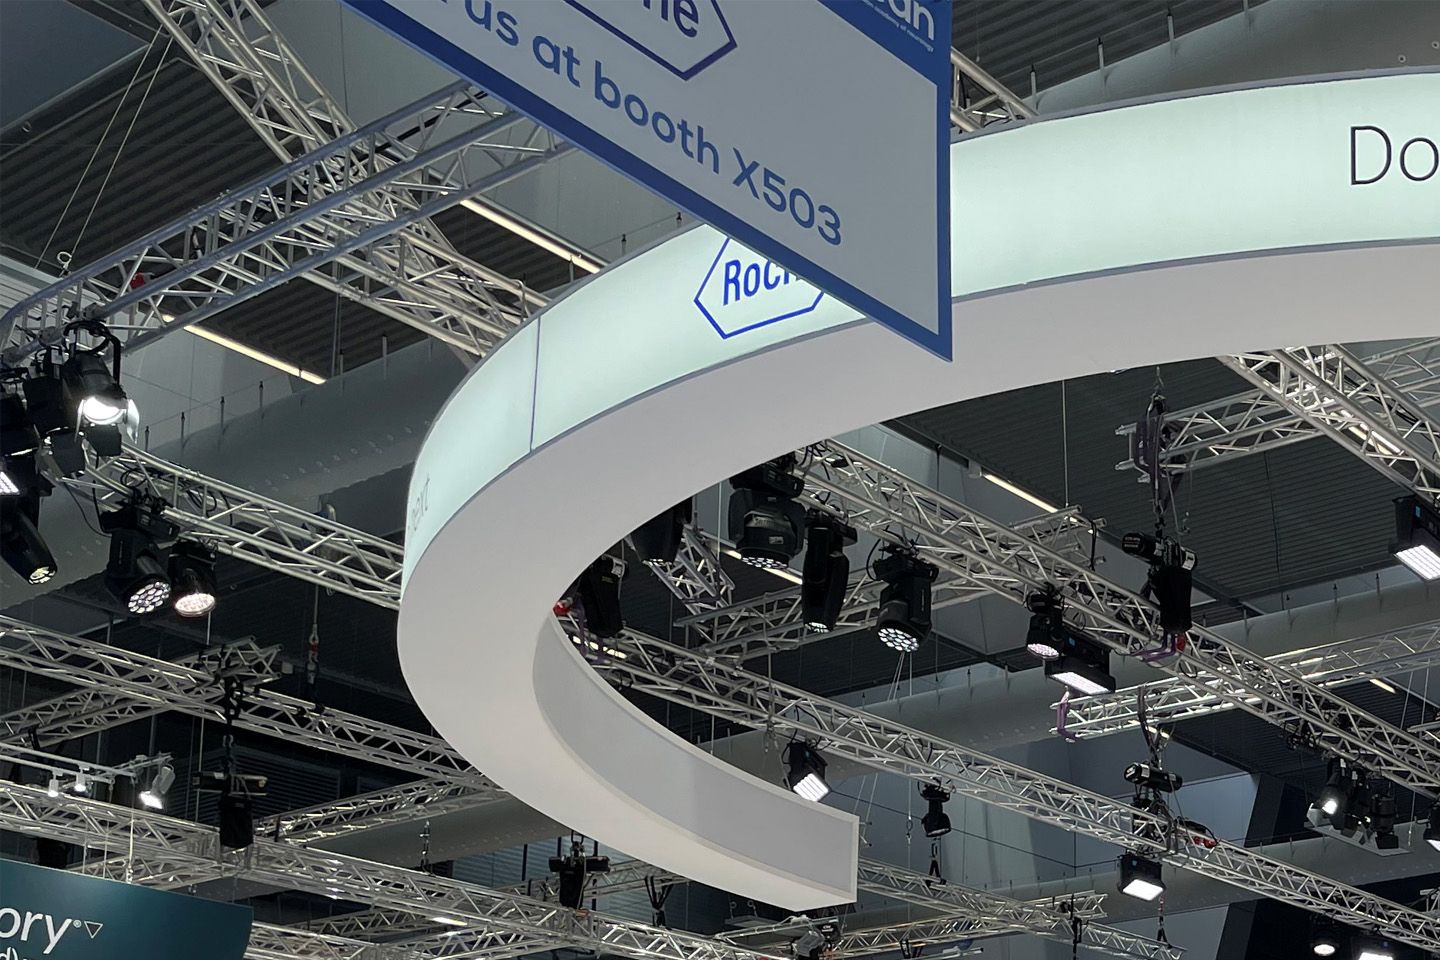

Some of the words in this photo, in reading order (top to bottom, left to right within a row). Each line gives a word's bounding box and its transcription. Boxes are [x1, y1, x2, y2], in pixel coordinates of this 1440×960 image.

[532, 35, 580, 88] at
[595, 59, 719, 175] booth
[732, 147, 841, 246] X503
[723, 259, 790, 306] Roc
